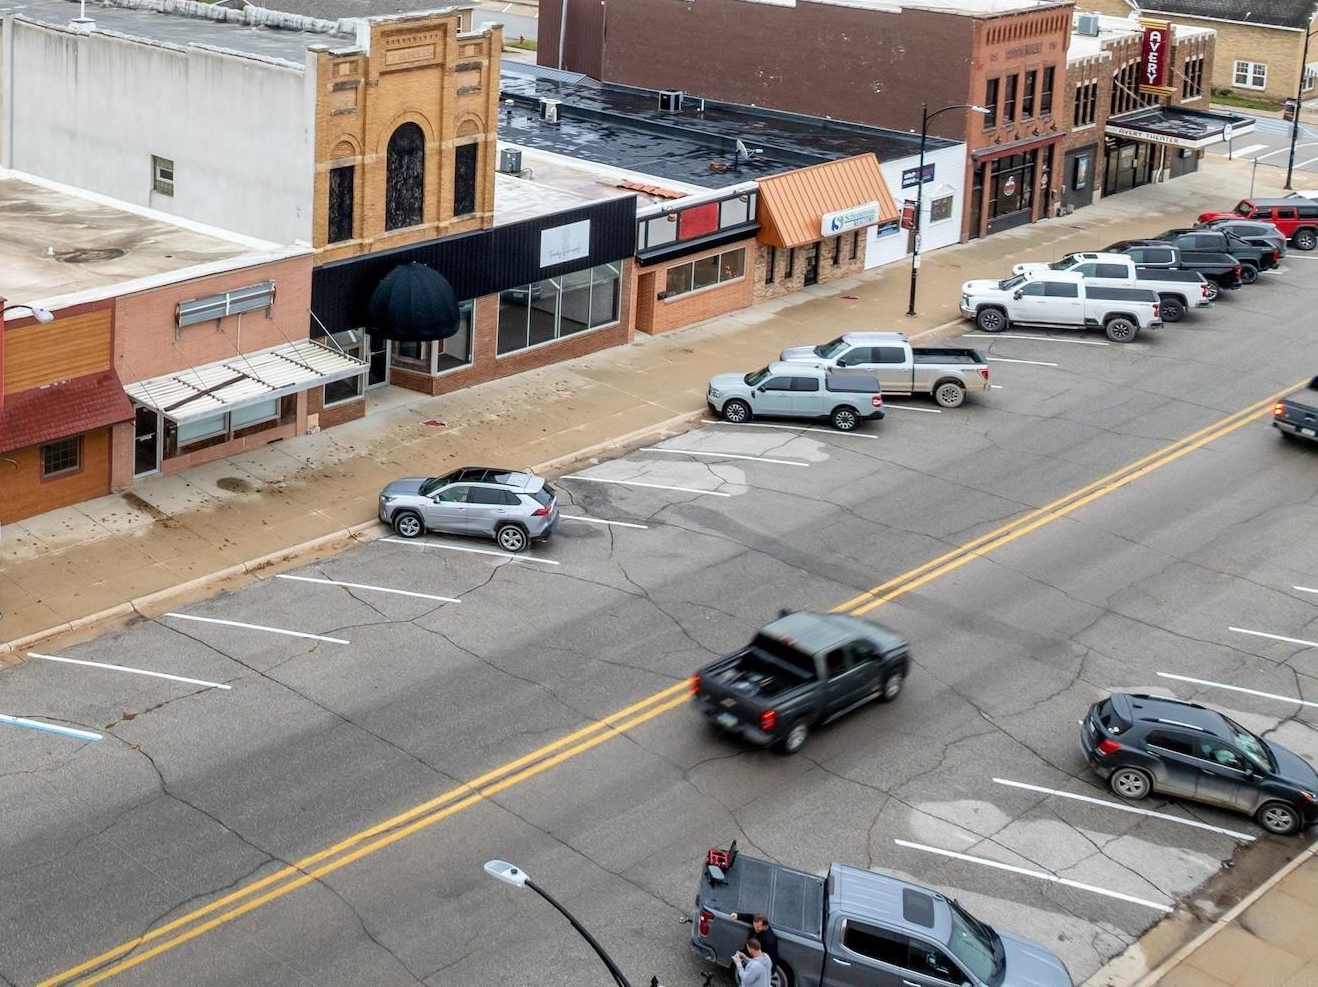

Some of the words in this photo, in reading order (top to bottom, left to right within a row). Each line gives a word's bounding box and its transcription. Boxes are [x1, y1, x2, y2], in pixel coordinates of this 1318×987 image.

[1146, 30, 1161, 84] AVERY
[1118, 128, 1144, 138] AVERY
[1146, 133, 1179, 144] THEATER
